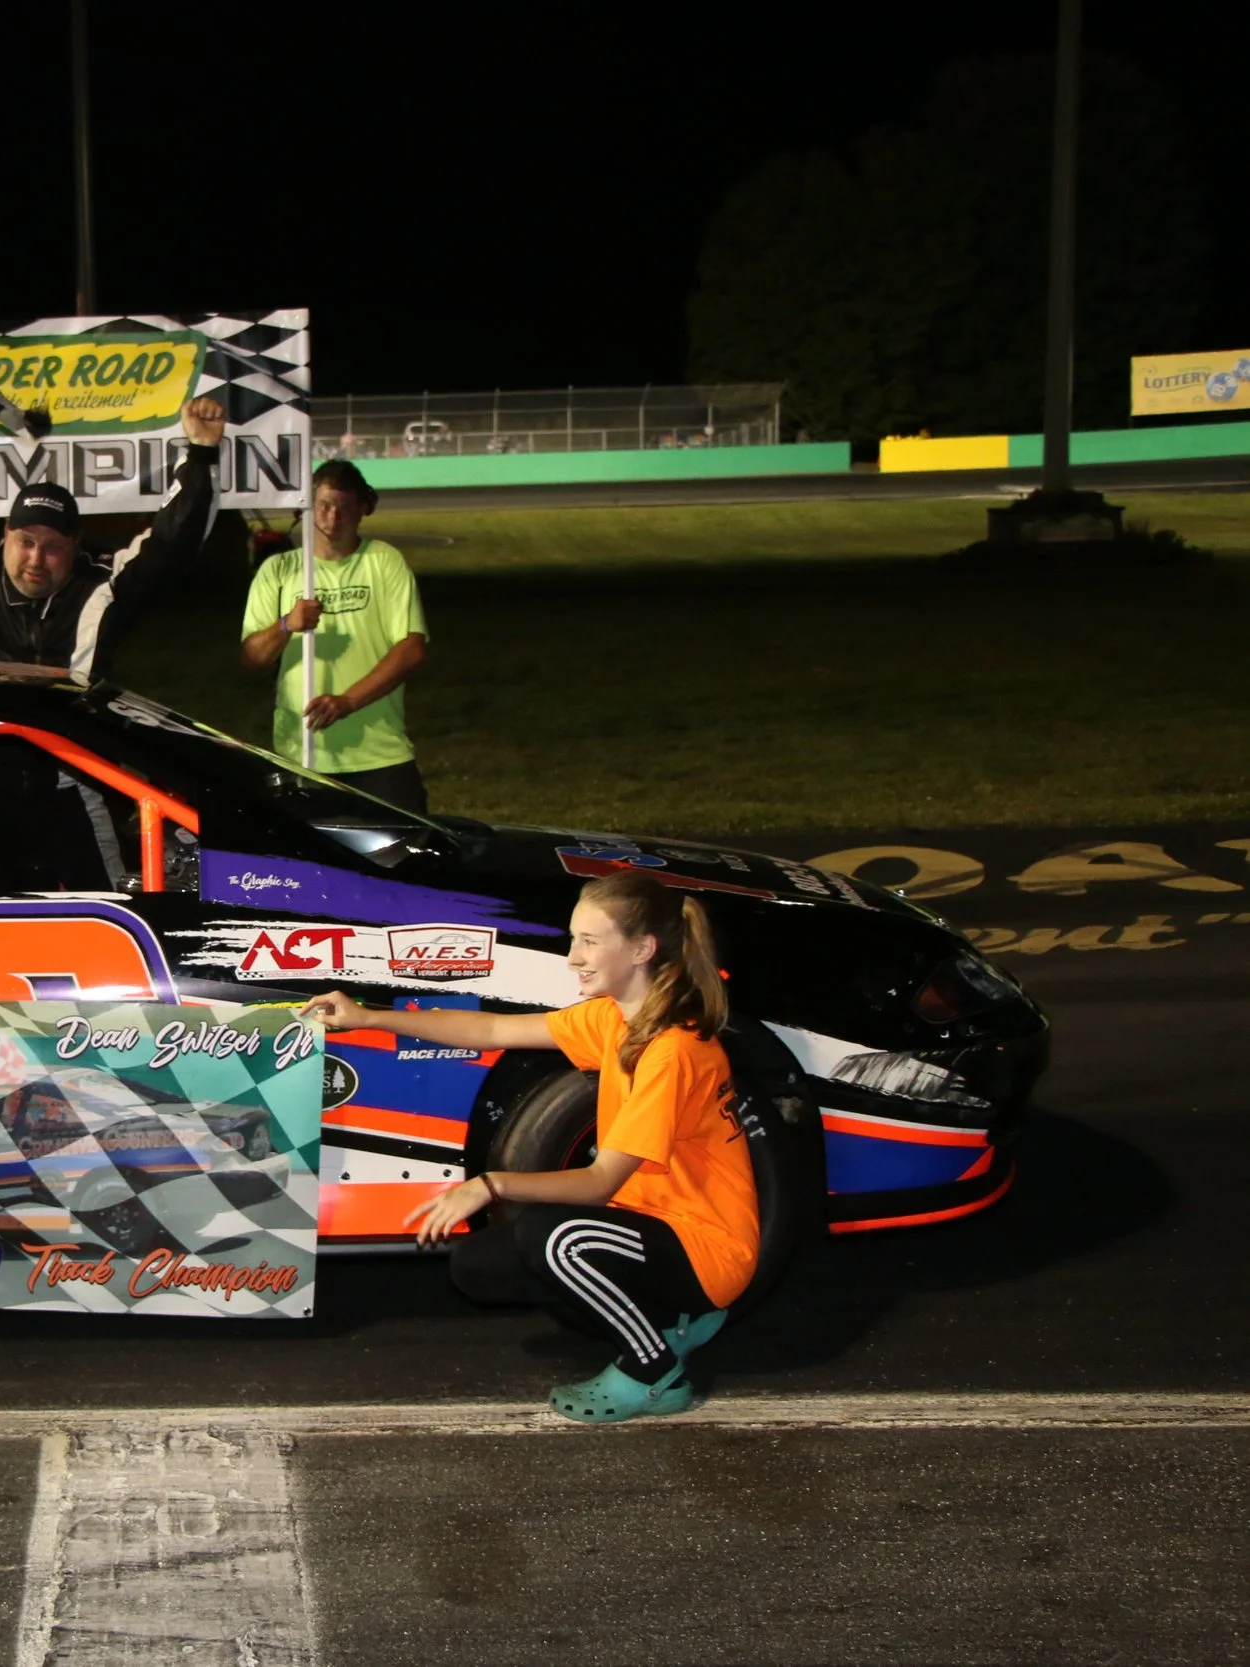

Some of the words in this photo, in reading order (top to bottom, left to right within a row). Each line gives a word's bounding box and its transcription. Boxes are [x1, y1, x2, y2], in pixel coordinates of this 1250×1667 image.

[68, 351, 176, 388] ROAD
[1144, 371, 1211, 389] LOTTERY
[240, 871, 283, 891] Graphic
[239, 928, 357, 971] ACT
[56, 1015, 140, 1060] Dean
[149, 1021, 262, 1070] Switser
[272, 1021, 314, 1070] Jr
[397, 1049, 435, 1061] RACE
[436, 1048, 480, 1060] FUELS
[20, 1242, 116, 1293] Track
[128, 1247, 299, 1301] Champion
